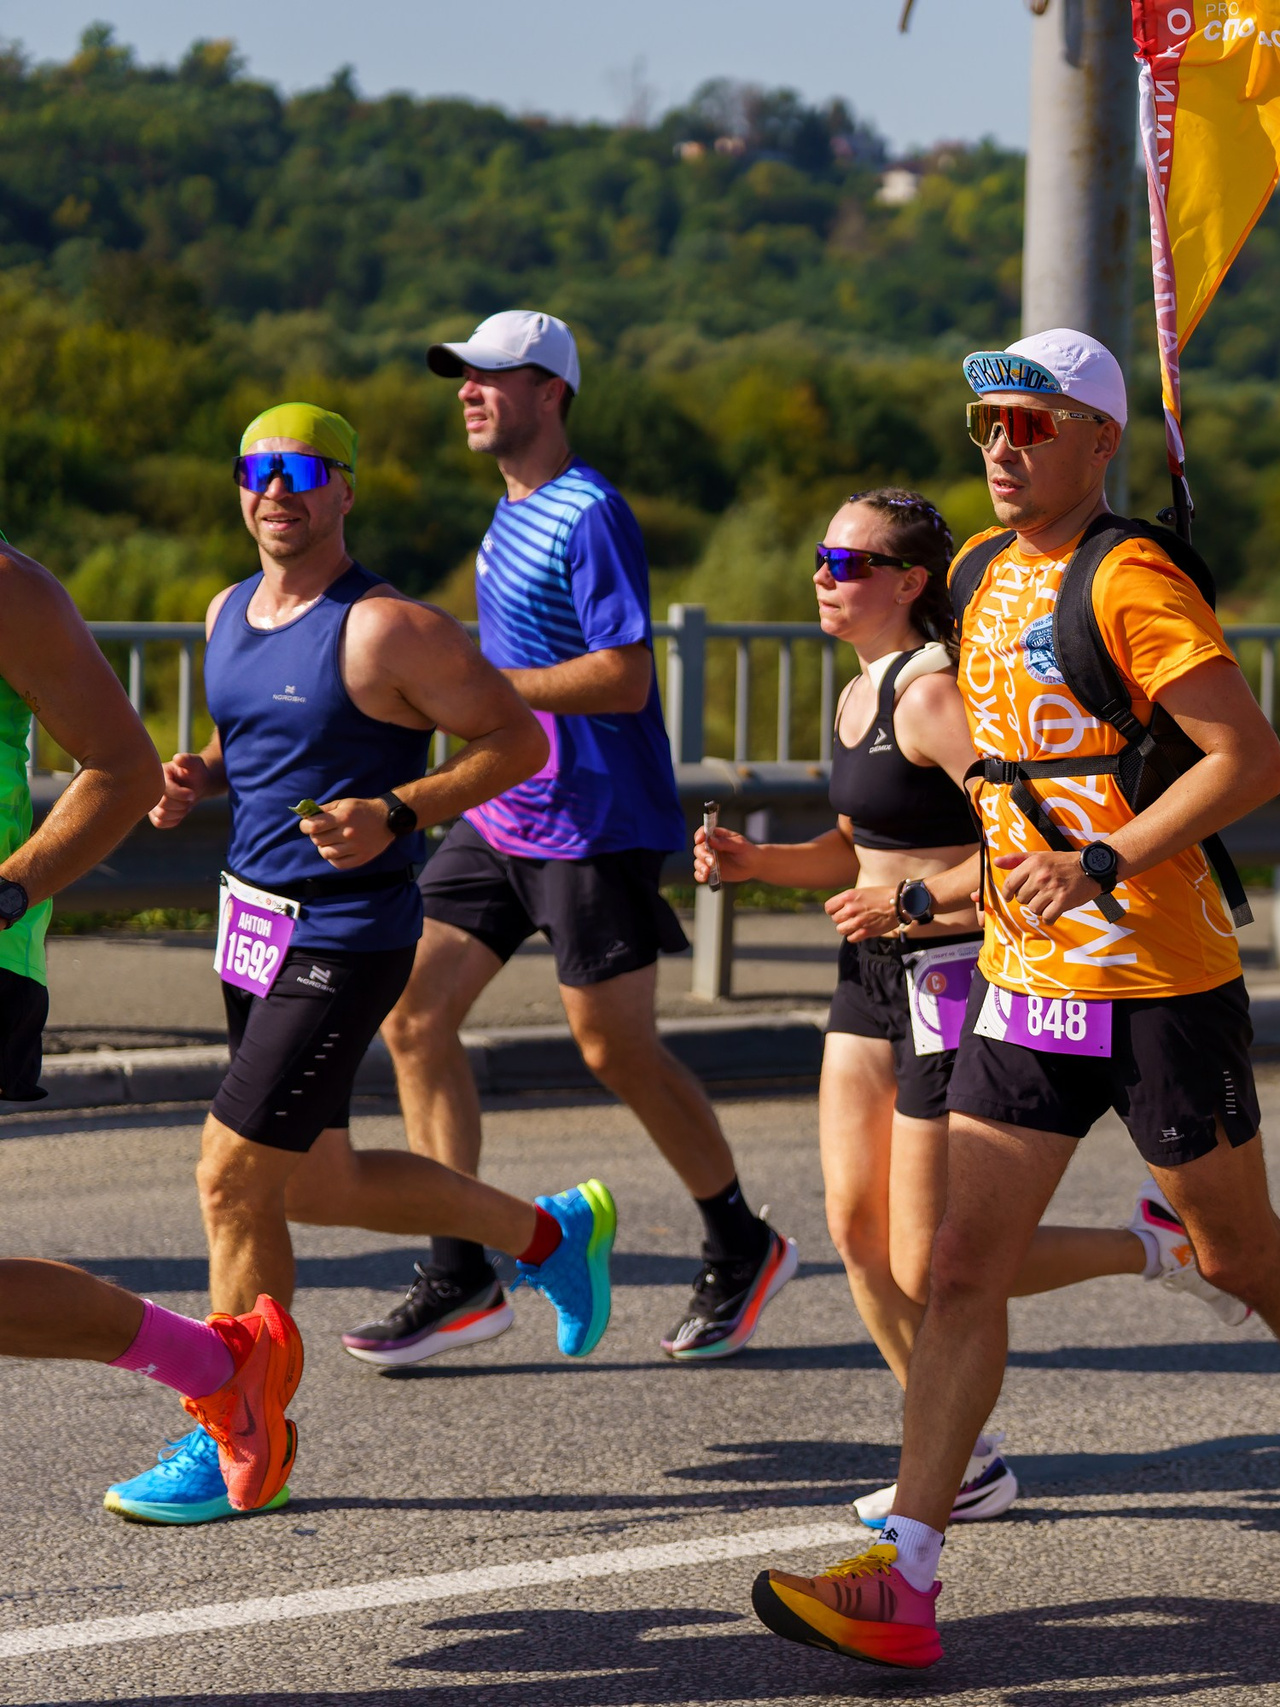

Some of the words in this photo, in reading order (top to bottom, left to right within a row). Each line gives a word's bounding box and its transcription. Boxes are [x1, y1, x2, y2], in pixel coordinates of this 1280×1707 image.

[1205, 2, 1240, 17] PRO
[237, 911, 273, 939] АНТОН
[225, 931, 280, 986] 1592
[1027, 995, 1087, 1041] 848
